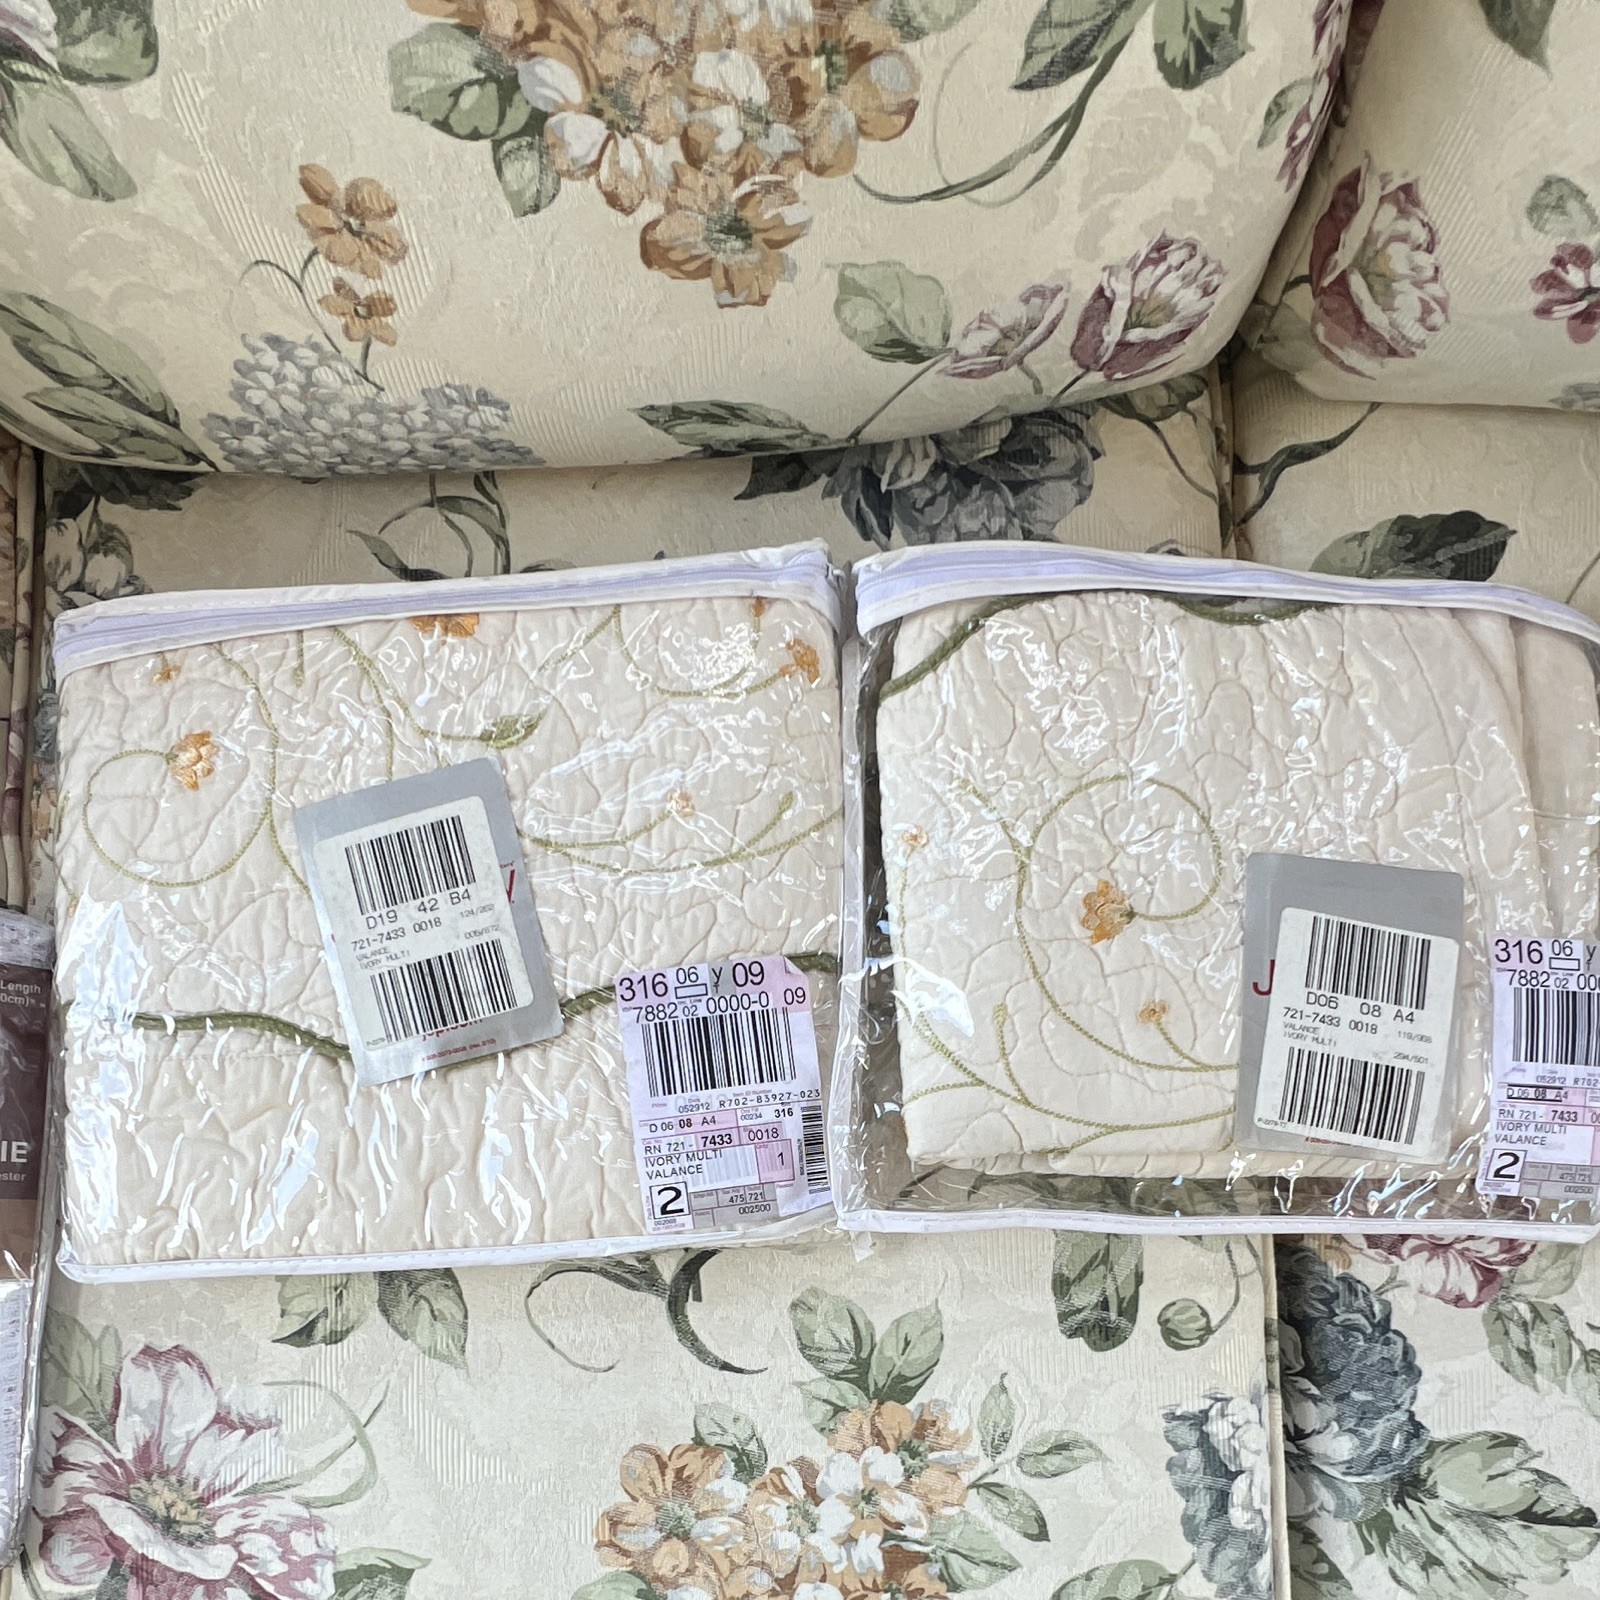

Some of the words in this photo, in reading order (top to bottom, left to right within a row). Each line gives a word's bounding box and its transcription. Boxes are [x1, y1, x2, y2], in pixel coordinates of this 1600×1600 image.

[366, 909, 398, 930] D19
[418, 898, 439, 913] 42
[449, 889, 471, 905] B4
[352, 927, 406, 951] 721-7433
[413, 917, 442, 933] 0018
[1495, 939, 1543, 964] 316
[1552, 939, 1573, 957] 06
[0, 980, 41, 995] Length
[619, 973, 668, 1001] 316
[676, 966, 699, 984] 06
[732, 960, 765, 988] 09
[1507, 969, 1550, 987] 7882
[1554, 977, 1569, 989] 02
[1577, 973, 1600, 991] 00
[633, 1001, 678, 1023] 7882
[682, 1006, 699, 1017] 02
[706, 991, 769, 1014] 0000-0
[783, 987, 806, 1006] 09
[1306, 991, 1339, 1010] D06
[1360, 1002, 1382, 1018] 08
[1393, 1009, 1415, 1025] A4
[1283, 1007, 1341, 1028] 721-7433
[1349, 1020, 1378, 1035] 0018
[719, 1089, 820, 1108] R702-83927-023
[1507, 1088, 1514, 1097] D
[1517, 1088, 1530, 1098] 06
[1534, 1089, 1547, 1099] 08
[678, 1102, 711, 1114] 052912
[774, 1108, 794, 1119] 316
[1498, 1109, 1515, 1119] RN
[1551, 1110, 1578, 1122] 7433
[649, 1123, 658, 1133] D
[661, 1121, 674, 1131] 06
[678, 1118, 693, 1129] 08
[701, 1115, 716, 1126] A4
[1496, 1121, 1531, 1132] IVORY
[1534, 1124, 1566, 1134] MULTI
[748, 1127, 779, 1141] 0018
[1494, 1134, 1547, 1146] VALANCE
[644, 1144, 662, 1155] RN
[701, 1133, 733, 1147] 7433
[644, 1152, 681, 1169] IVORY
[686, 1149, 722, 1163] MULTI
[777, 1151, 785, 1166] 1
[1493, 1152, 1520, 1179] 2
[0, 1172, 27, 1181] ster
[645, 1164, 704, 1181] VALANCE
[657, 1186, 685, 1216] 2
[728, 1194, 745, 1204] 475
[748, 1191, 764, 1202] 721
[738, 1203, 771, 1215] 002500
